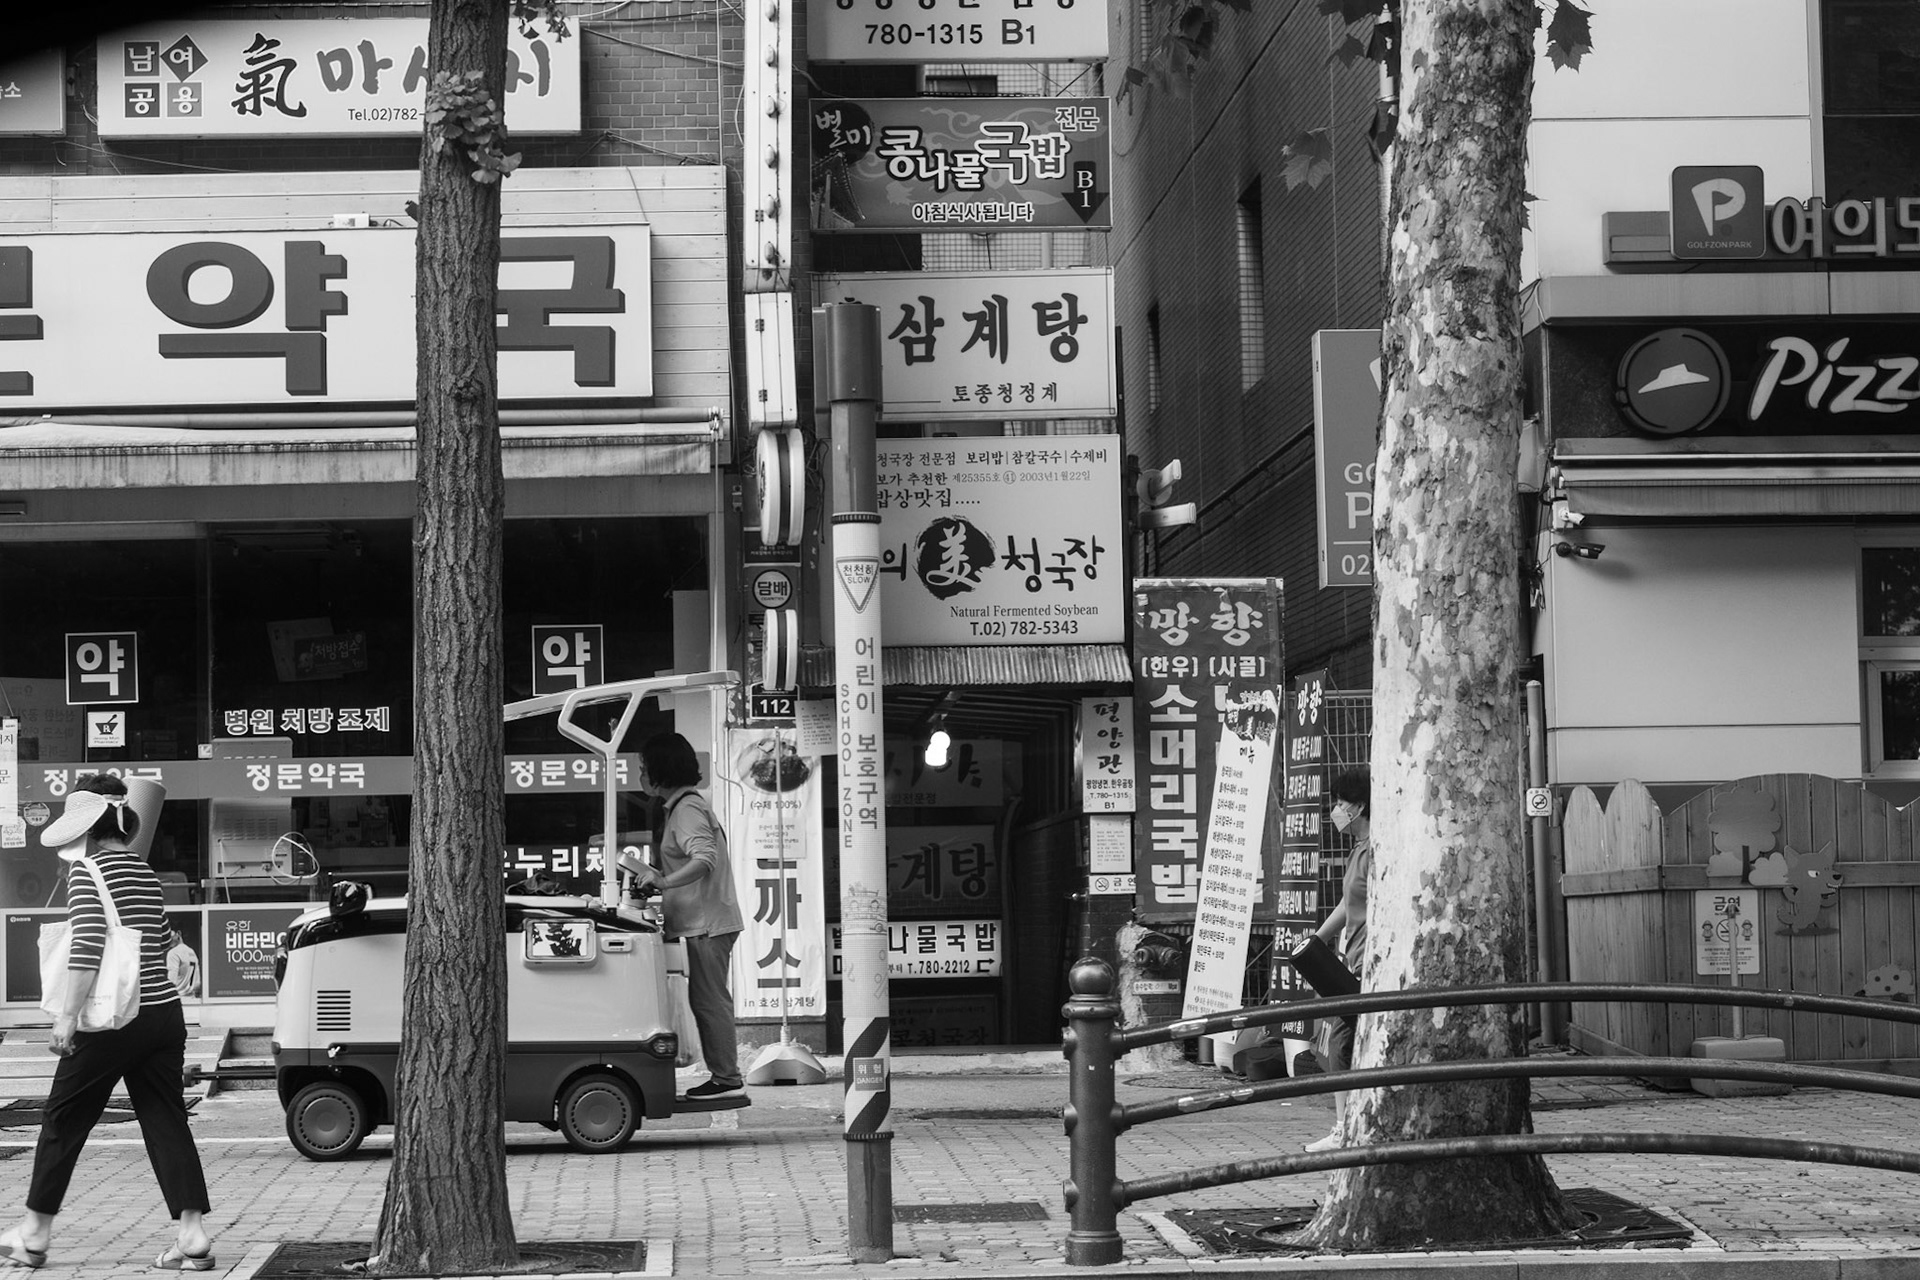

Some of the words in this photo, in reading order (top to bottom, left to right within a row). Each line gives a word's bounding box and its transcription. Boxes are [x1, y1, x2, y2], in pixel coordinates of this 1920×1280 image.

[865, 24, 983, 44] 780-1315
[1001, 18, 1035, 45] B1
[231, 33, 307, 118] 氣
[815, 109, 872, 149] 별미
[1055, 106, 1100, 132] 전문
[876, 121, 1072, 192] 콩나물국밥
[912, 202, 1034, 222] 아침식사됩니다
[1686, 240, 1727, 250] GOLFZON
[1728, 240, 1752, 249] PARK
[888, 292, 1089, 366] 삼계탕
[953, 382, 1058, 403] 토종청정계
[877, 452, 914, 467] 청국장
[918, 451, 956, 467] 전문점
[965, 451, 1003, 465] 보리밥
[1070, 449, 1107, 463] 수제비
[907, 472, 948, 486] 추천한
[843, 564, 874, 576] 천천히
[1001, 535, 1105, 593] 청국장
[757, 581, 788, 596] 담배
[847, 576, 870, 584] SLOW
[950, 604, 991, 618] Natural
[993, 603, 1052, 618] Fermented
[1053, 603, 1099, 618] Soybean
[1149, 601, 1264, 646] 망향
[970, 620, 1007, 638] T.02)
[1010, 619, 1079, 636] 782-5343
[76, 639, 125, 696] 약
[542, 632, 591, 688] 약
[855, 637, 876, 714] 어린이
[760, 700, 790, 714] 112
[224, 708, 273, 735] 병원
[841, 684, 851, 777] SCHOOL
[1092, 702, 1124, 775] 평양관
[1240, 746, 1255, 764] 메뉴
[246, 763, 365, 790] 정문약국
[857, 733, 878, 830] 보호구역
[1149, 685, 1202, 904] 소머리국밥
[843, 788, 853, 849] ZONE
[744, 998, 755, 1007] in
[857, 1077, 884, 1085] DANGER
[858, 1064, 882, 1074] 위험
